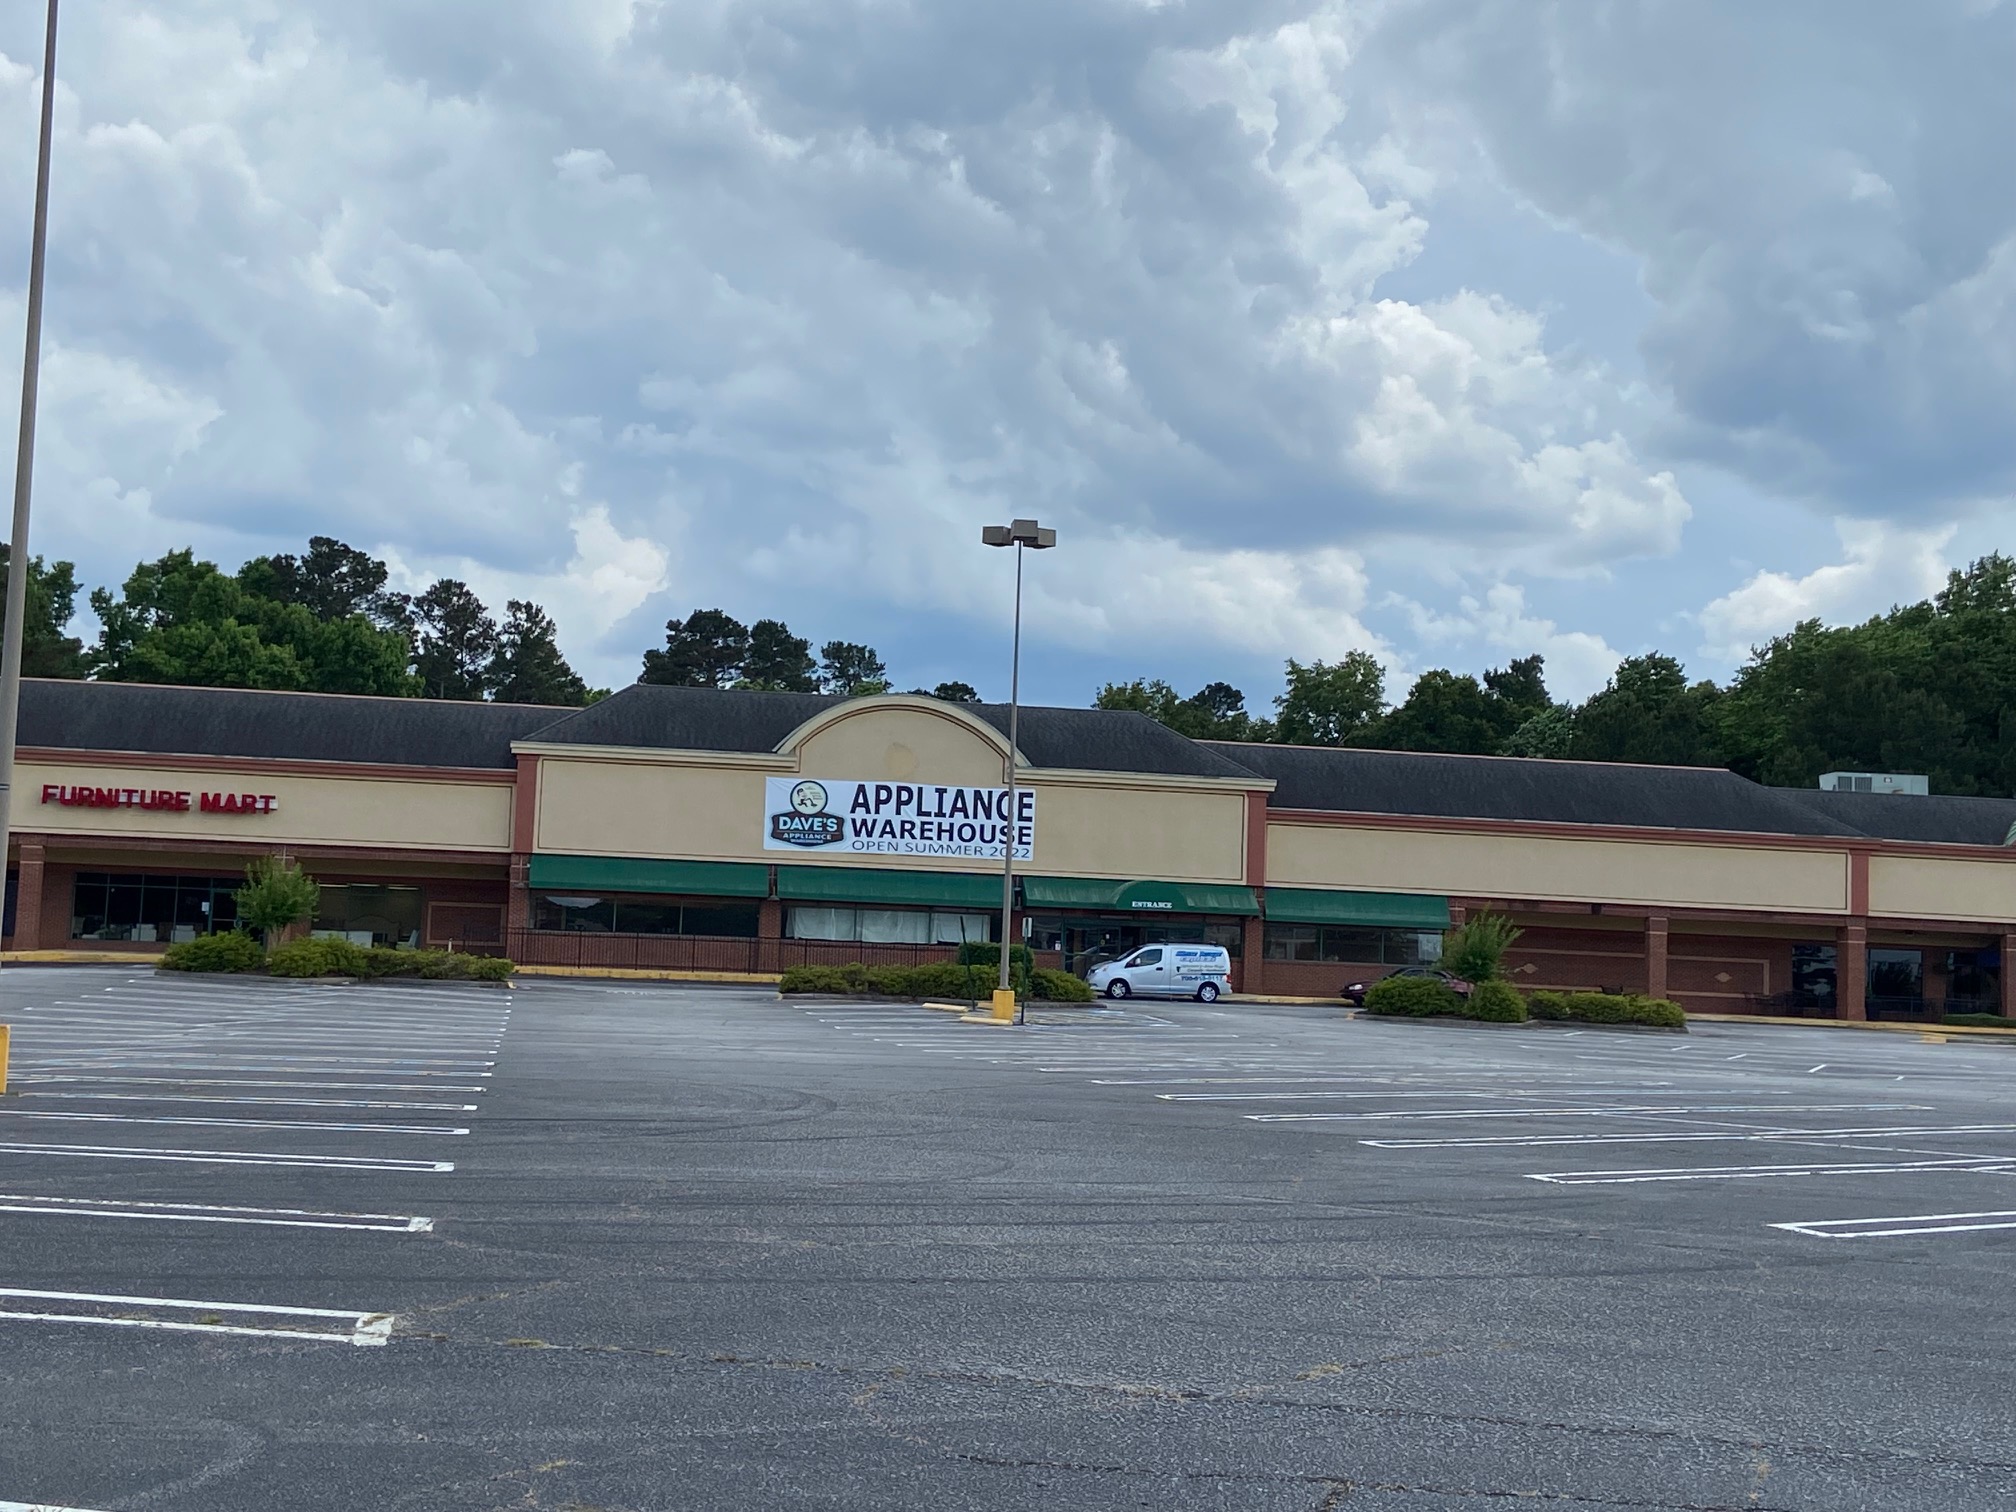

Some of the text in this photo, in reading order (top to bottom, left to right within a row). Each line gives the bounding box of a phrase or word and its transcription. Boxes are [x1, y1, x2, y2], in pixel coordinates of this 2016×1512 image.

[41, 784, 277, 814] FURNITURE MART
[850, 784, 1034, 822] APPLIANCE
[779, 816, 838, 832] DAVE'S
[850, 817, 1032, 846] WAREHOUSE
[783, 832, 832, 840] APPLIANCE
[852, 840, 1030, 858] OPEN SUMMER 2022
[1131, 900, 1173, 909] ENTRANCE
